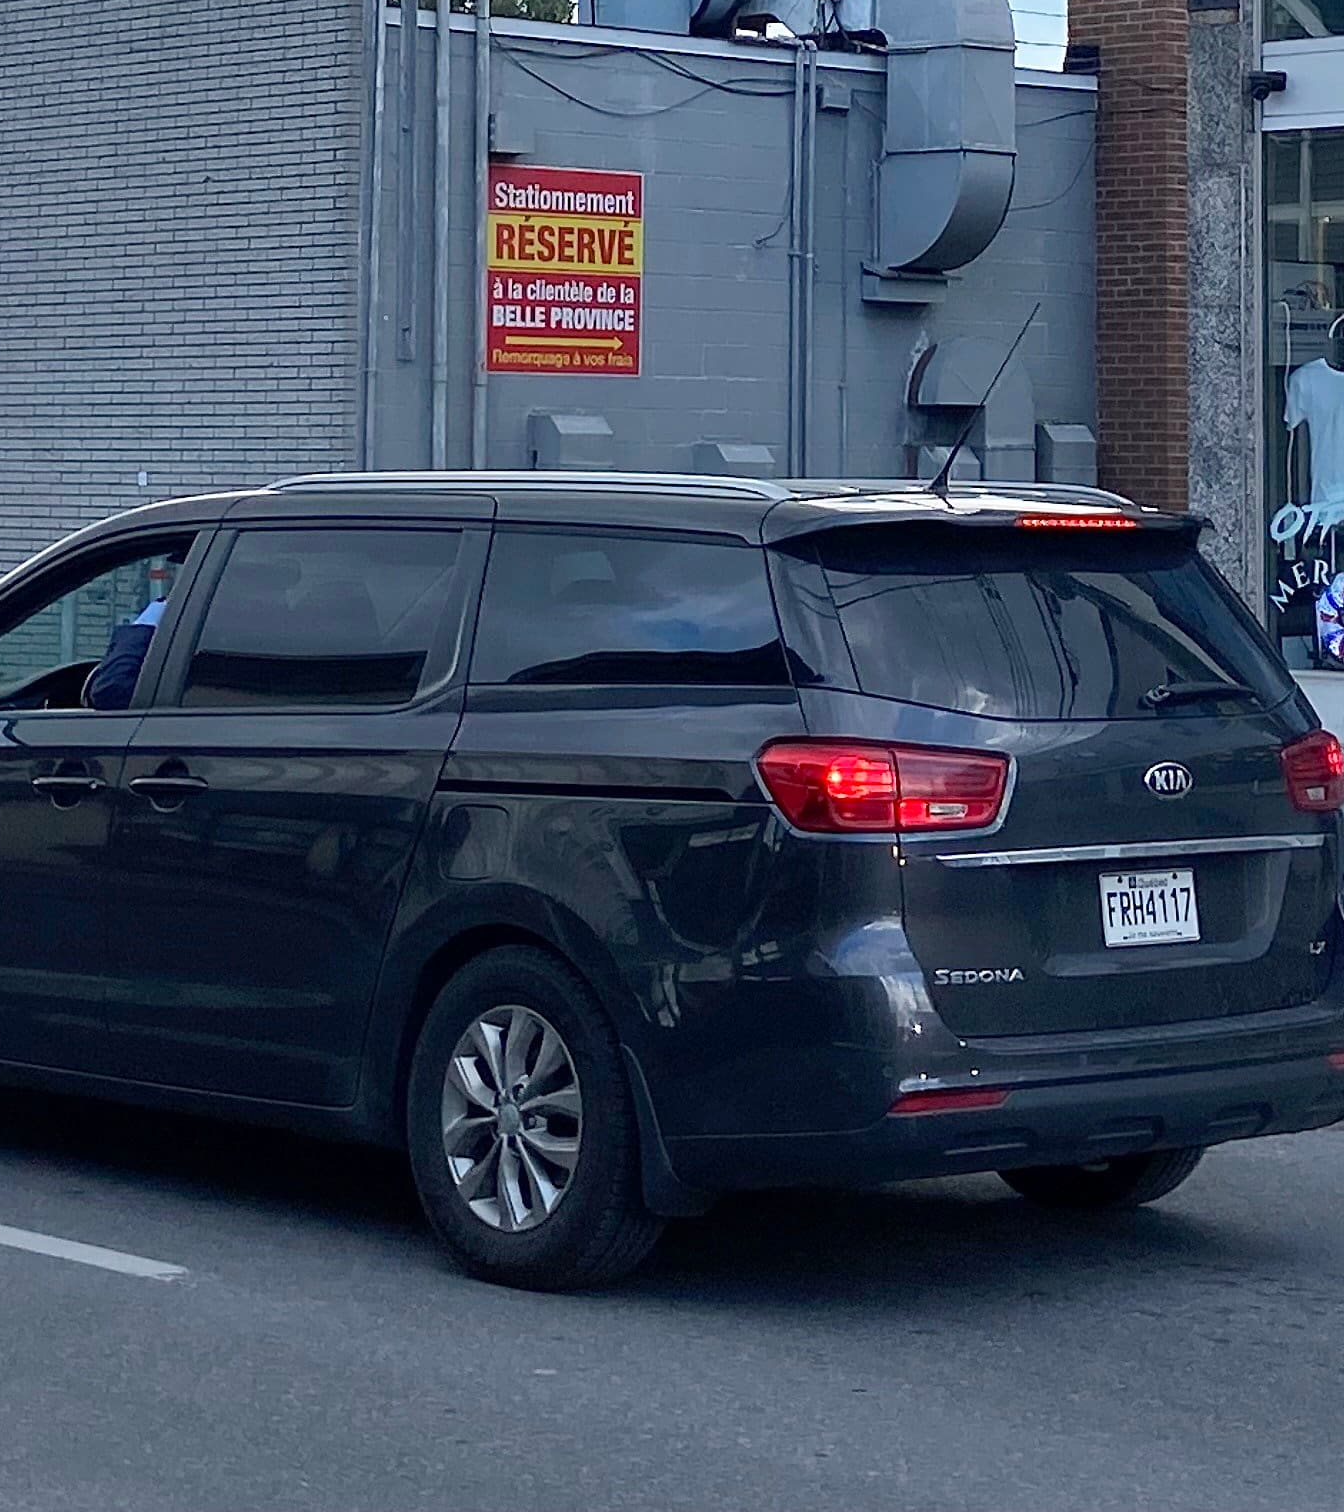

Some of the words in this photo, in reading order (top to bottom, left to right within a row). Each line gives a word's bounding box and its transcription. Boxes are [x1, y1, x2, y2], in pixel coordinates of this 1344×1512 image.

[494, 182, 635, 215] Stationnement
[495, 215, 635, 266] RÉSERVÉ
[492, 277, 503, 299] à
[507, 278, 523, 300] la
[526, 279, 593, 303] clientèle
[597, 281, 616, 303] de
[620, 283, 635, 304] la
[492, 305, 546, 329] BELLE
[550, 306, 635, 331] PROVINCE
[492, 349, 570, 368] Remorquage
[572, 350, 582, 366] à
[584, 354, 606, 367] vos
[607, 352, 634, 367] frais
[1153, 769, 1187, 792] KIA
[1106, 887, 1191, 928] FRH4117
[934, 968, 1025, 985] SEDONA
